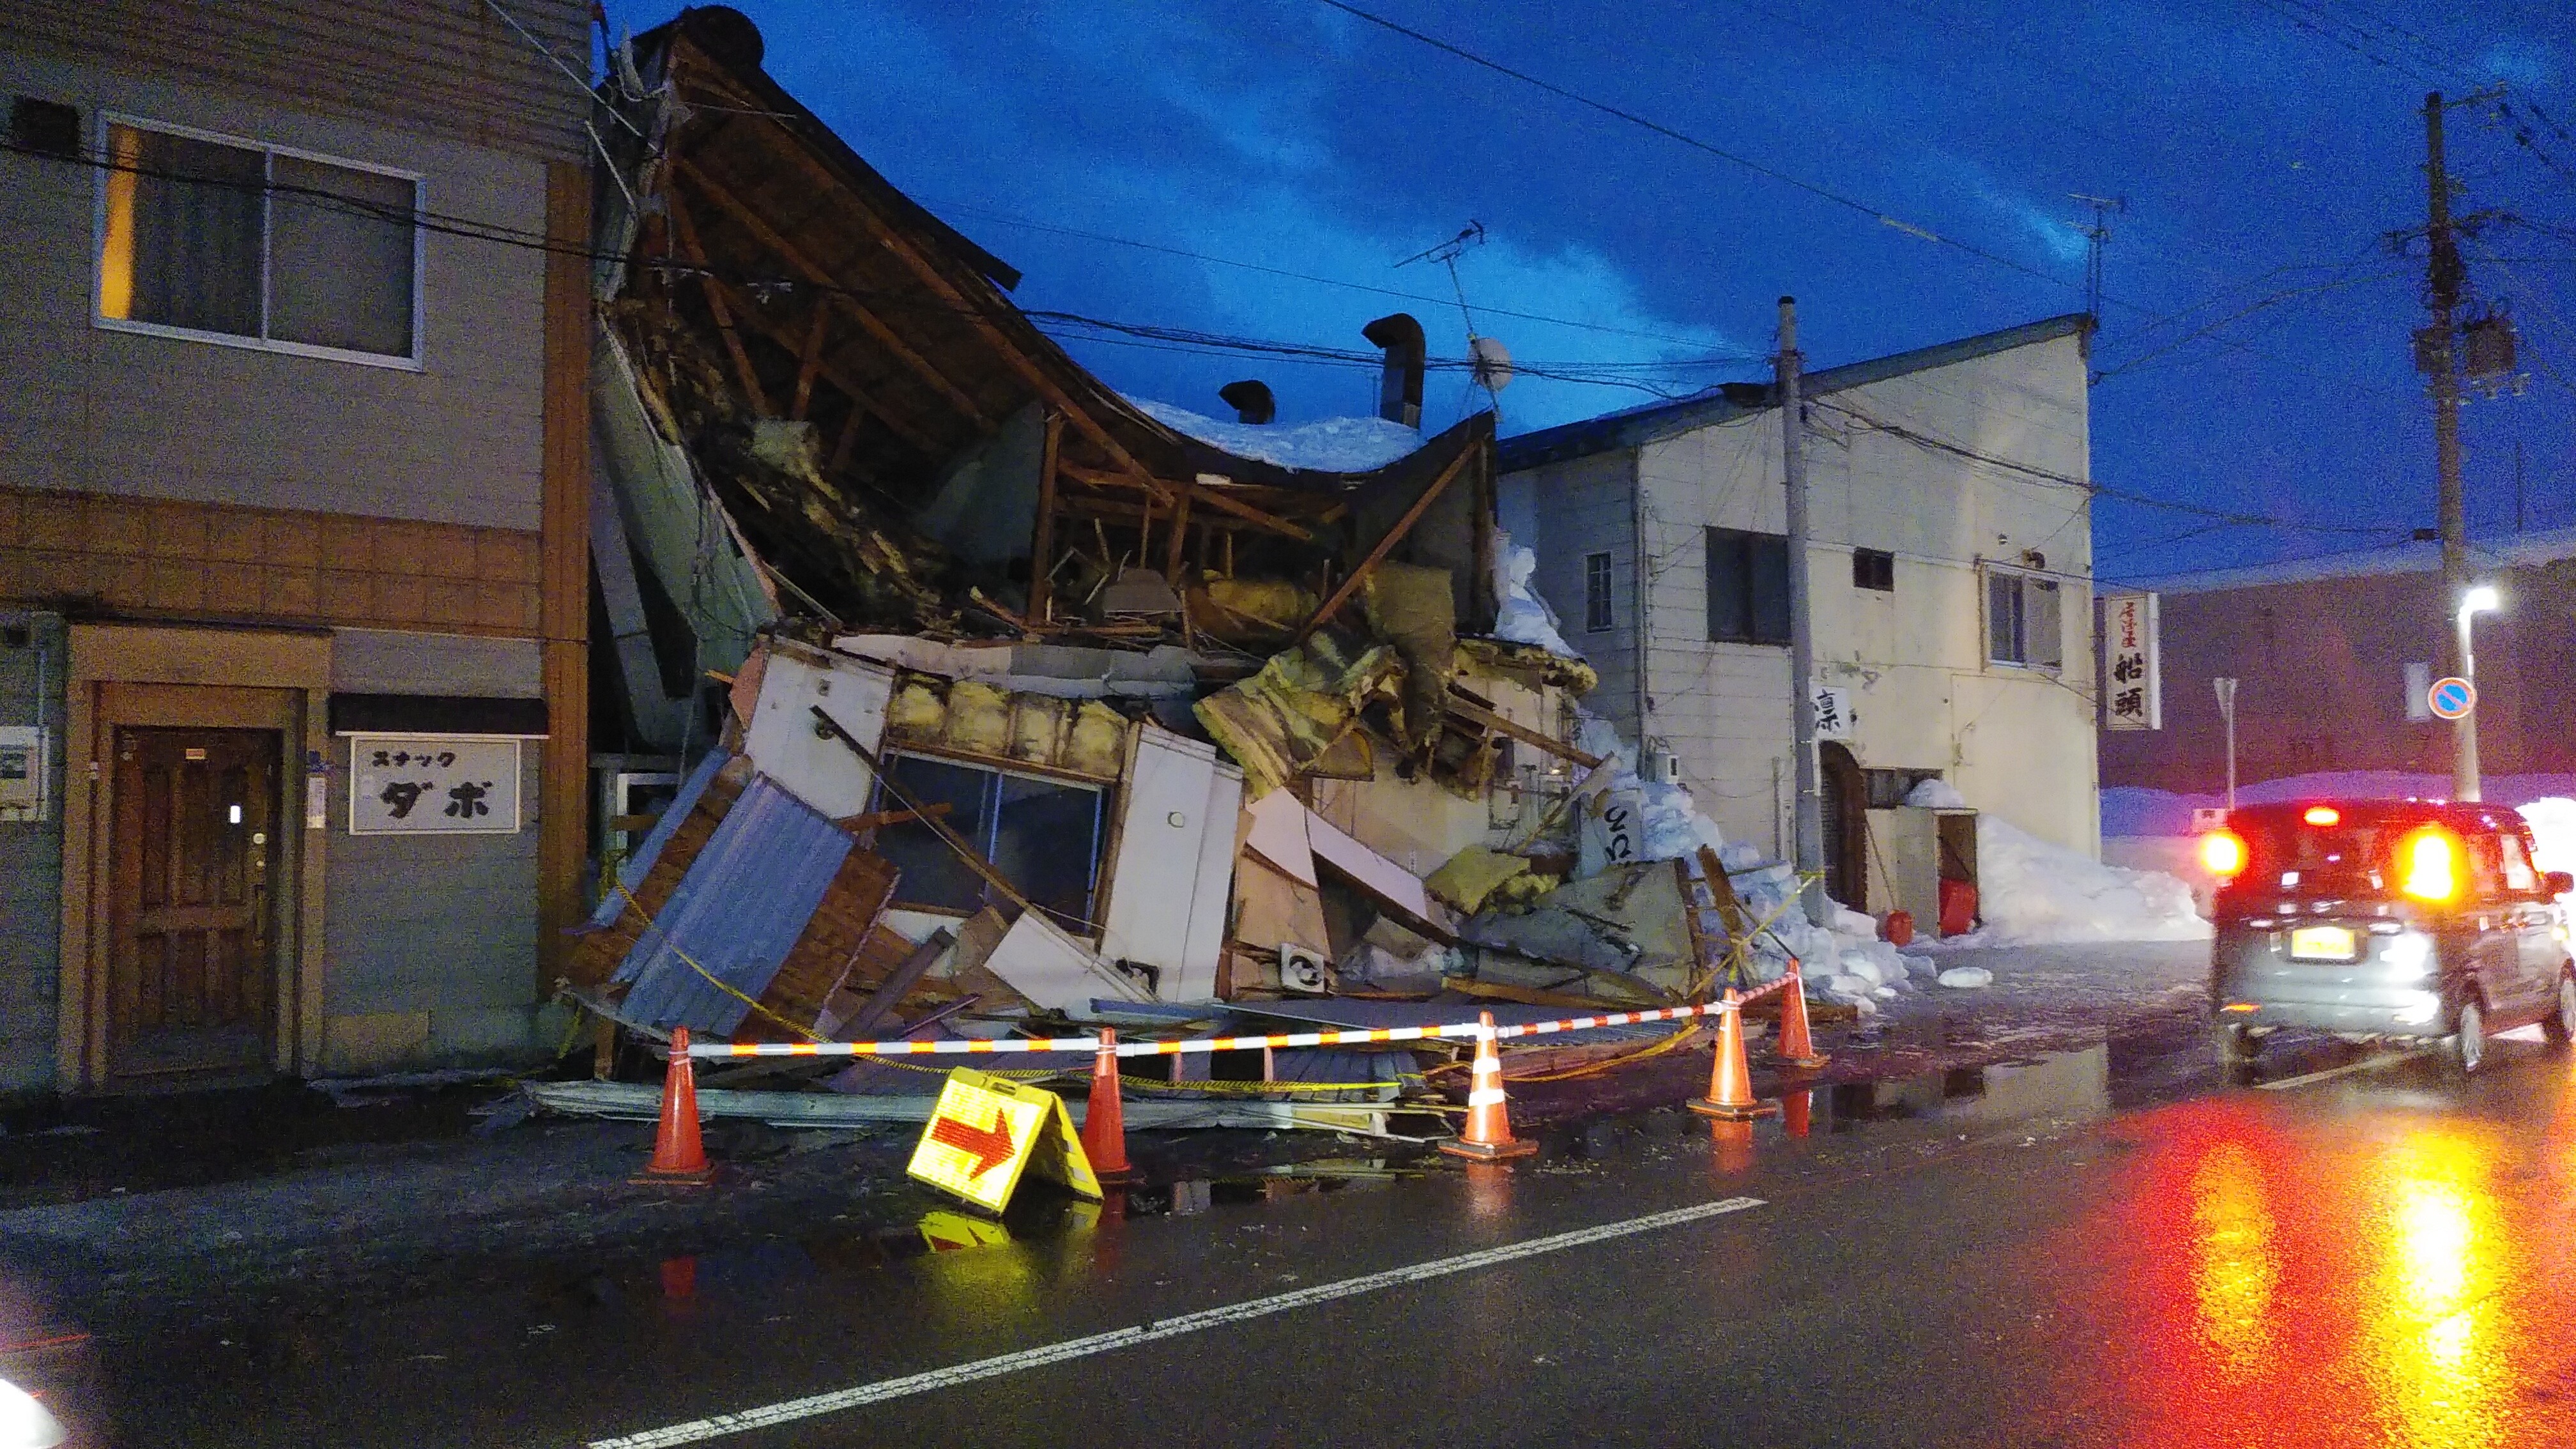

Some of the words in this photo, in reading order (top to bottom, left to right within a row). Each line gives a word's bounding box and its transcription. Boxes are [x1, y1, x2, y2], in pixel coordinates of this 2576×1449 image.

[2113, 652, 2143, 717] 船頭
[372, 750, 456, 767] スナック
